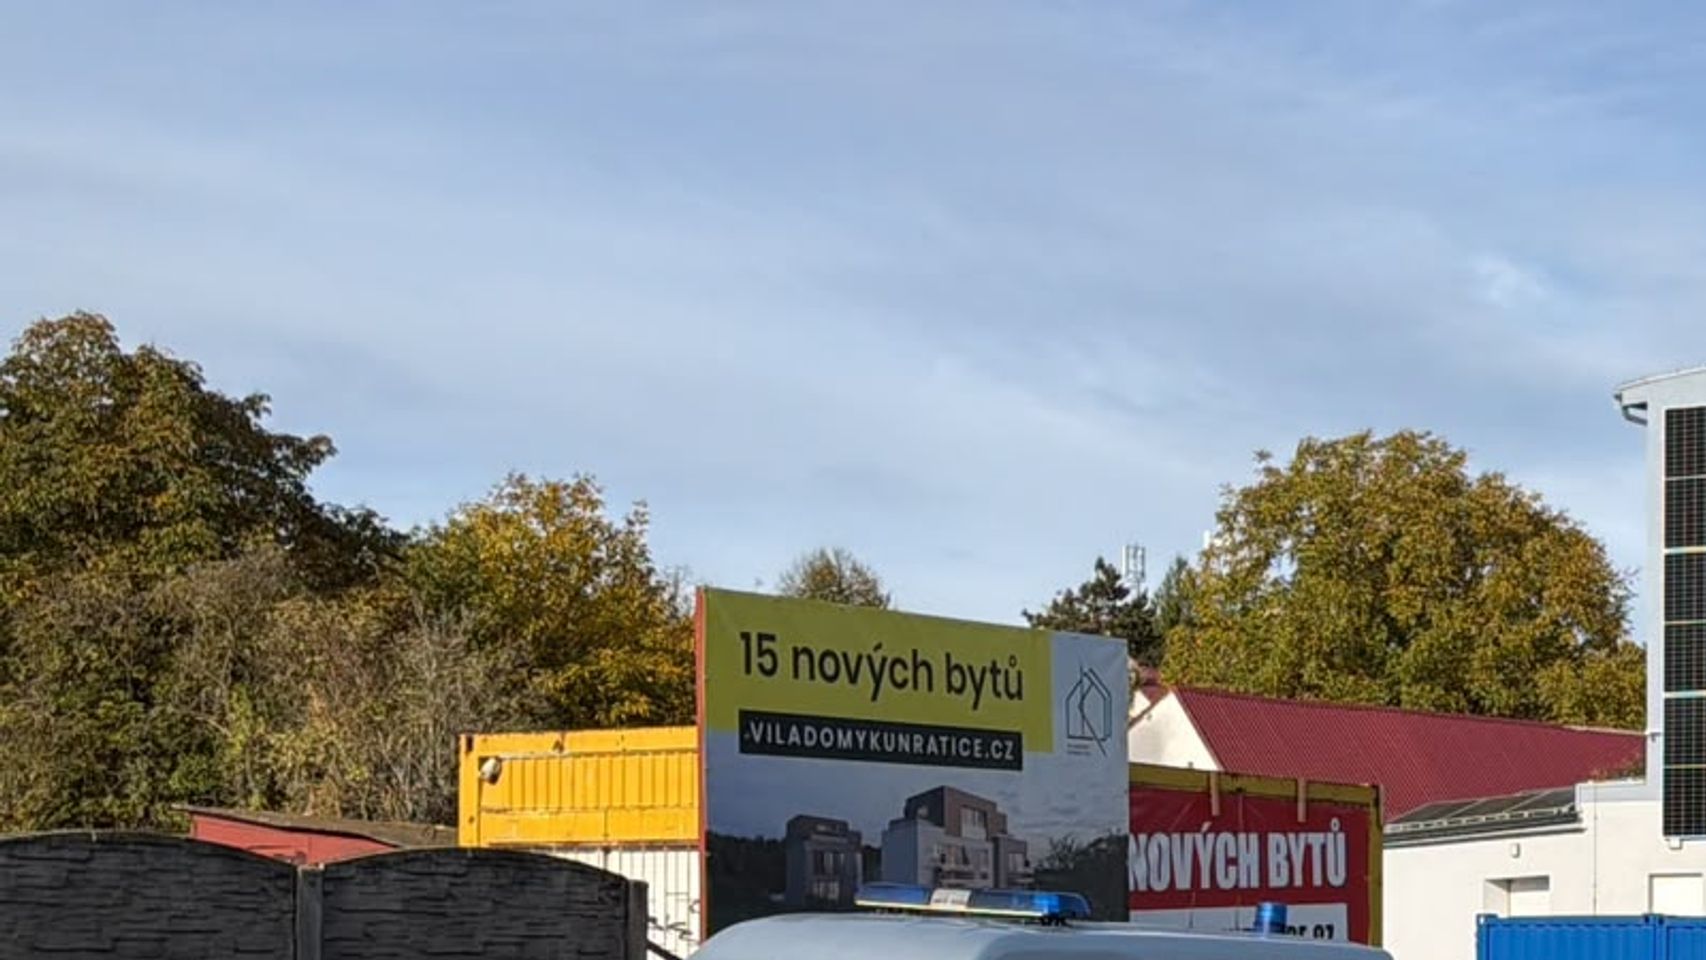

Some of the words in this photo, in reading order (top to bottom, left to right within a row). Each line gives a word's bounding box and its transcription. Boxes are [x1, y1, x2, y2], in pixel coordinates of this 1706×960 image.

[740, 632, 778, 677] 15
[792, 643, 934, 702] nových
[946, 653, 1024, 711] bytů
[749, 721, 1015, 761] VILADOMYKUNRATICE.CZ
[1128, 821, 1261, 892] NOVÝCH
[1267, 817, 1347, 888] BYTŮ
